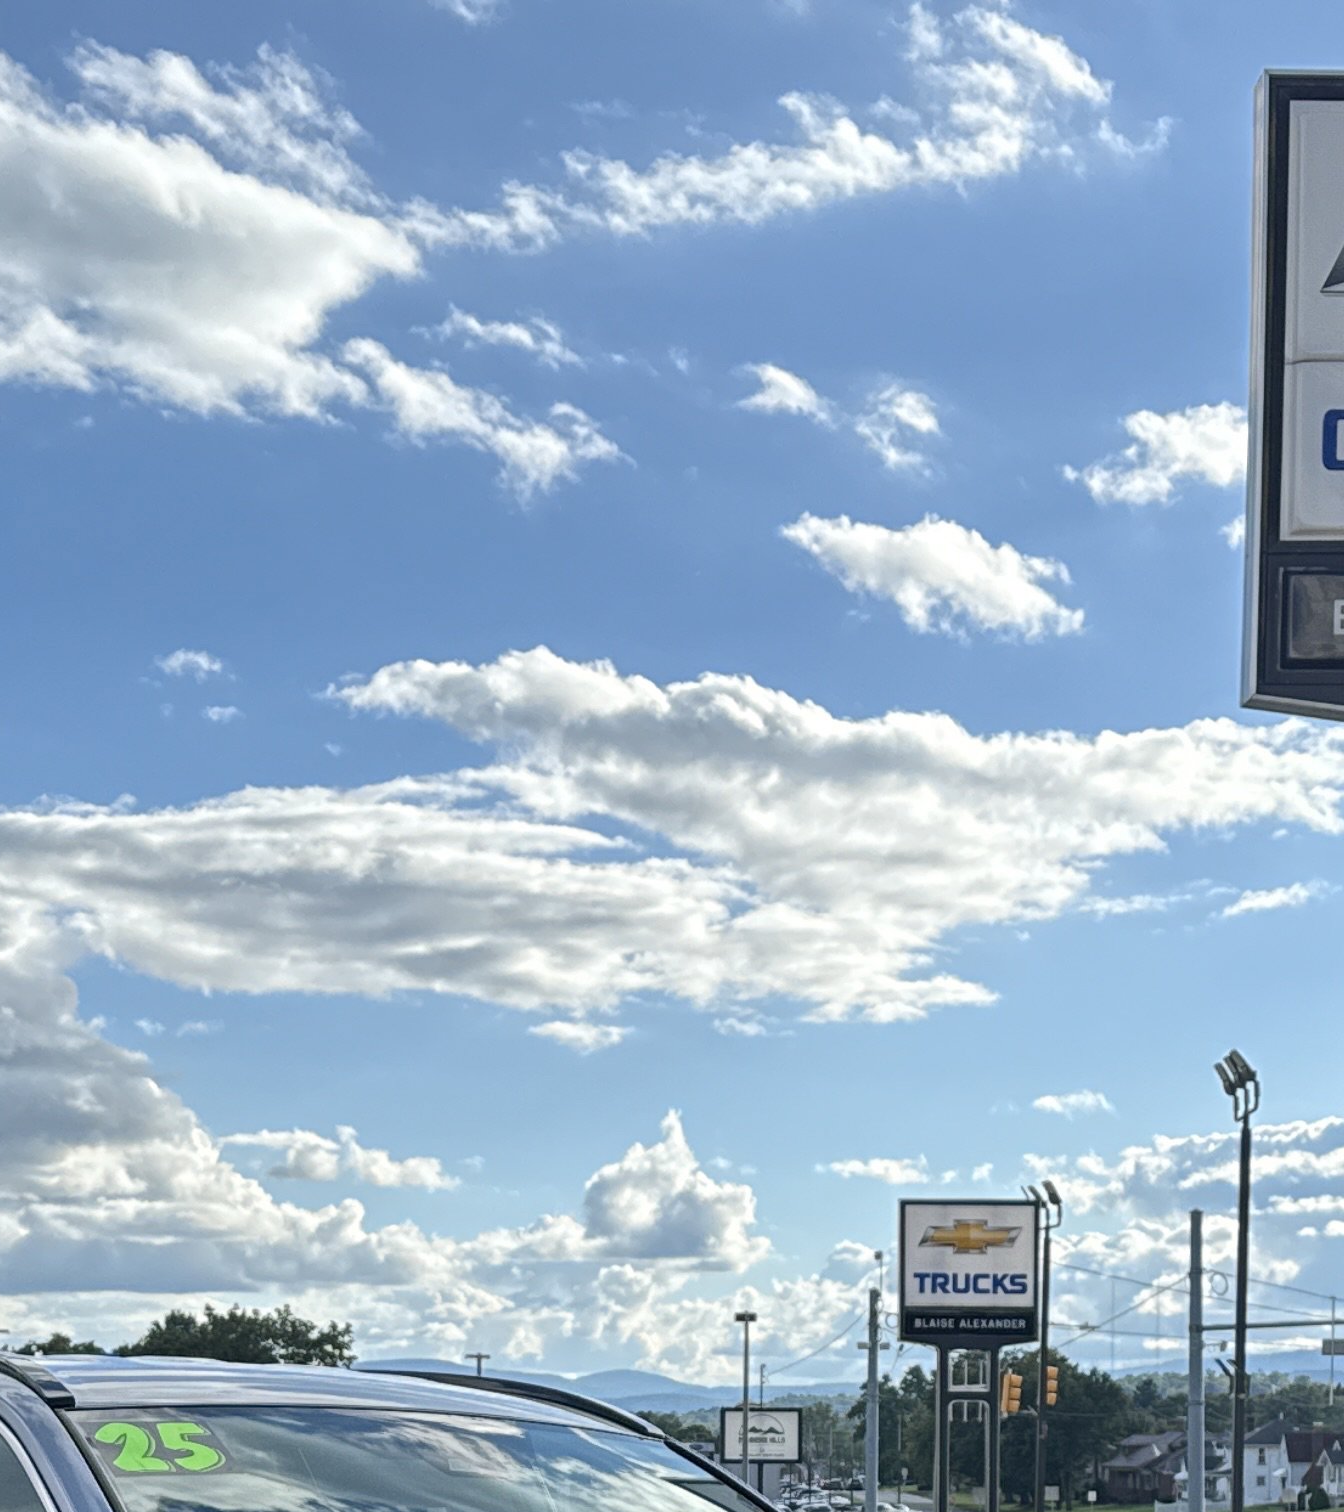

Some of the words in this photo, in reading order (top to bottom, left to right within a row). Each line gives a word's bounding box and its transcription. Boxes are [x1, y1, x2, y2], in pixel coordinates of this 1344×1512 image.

[913, 1272, 1028, 1295] TRUCKS
[913, 1317, 956, 1329] BLAISE
[958, 1318, 1027, 1330] ALEXANDER
[94, 1421, 226, 1472] 25
